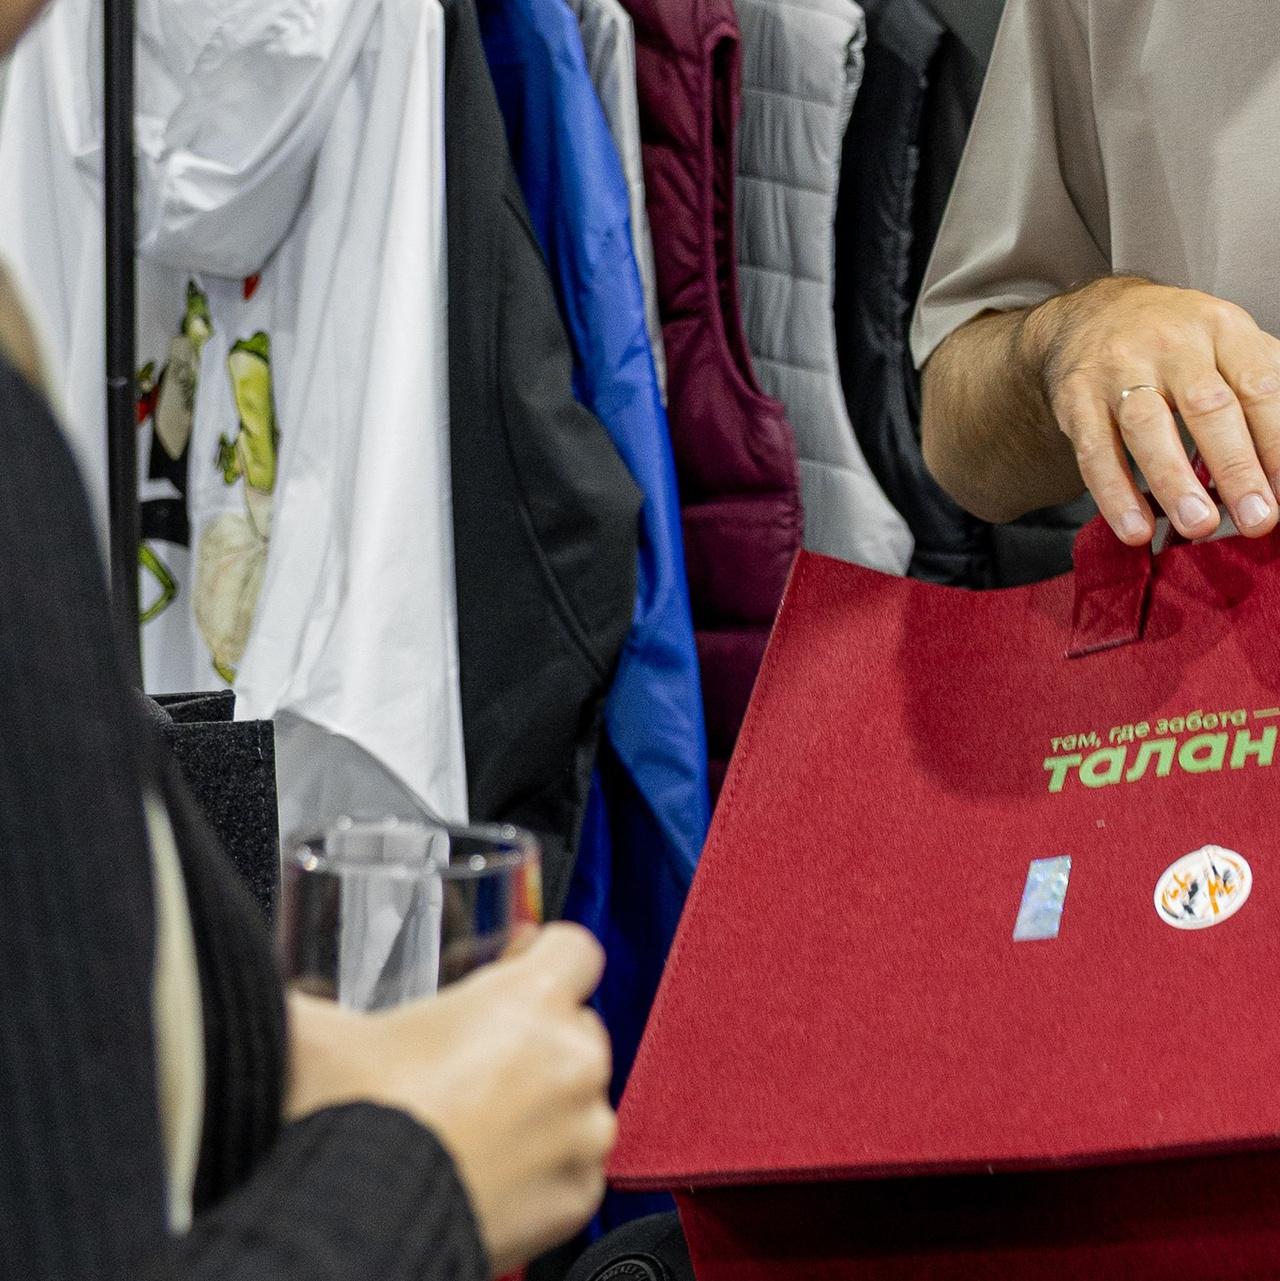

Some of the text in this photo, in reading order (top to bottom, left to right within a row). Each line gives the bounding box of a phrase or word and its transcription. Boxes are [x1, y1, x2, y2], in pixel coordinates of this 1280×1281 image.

[1050, 731, 1101, 753] там,
[1109, 720, 1151, 745] где
[1155, 709, 1248, 735] забота
